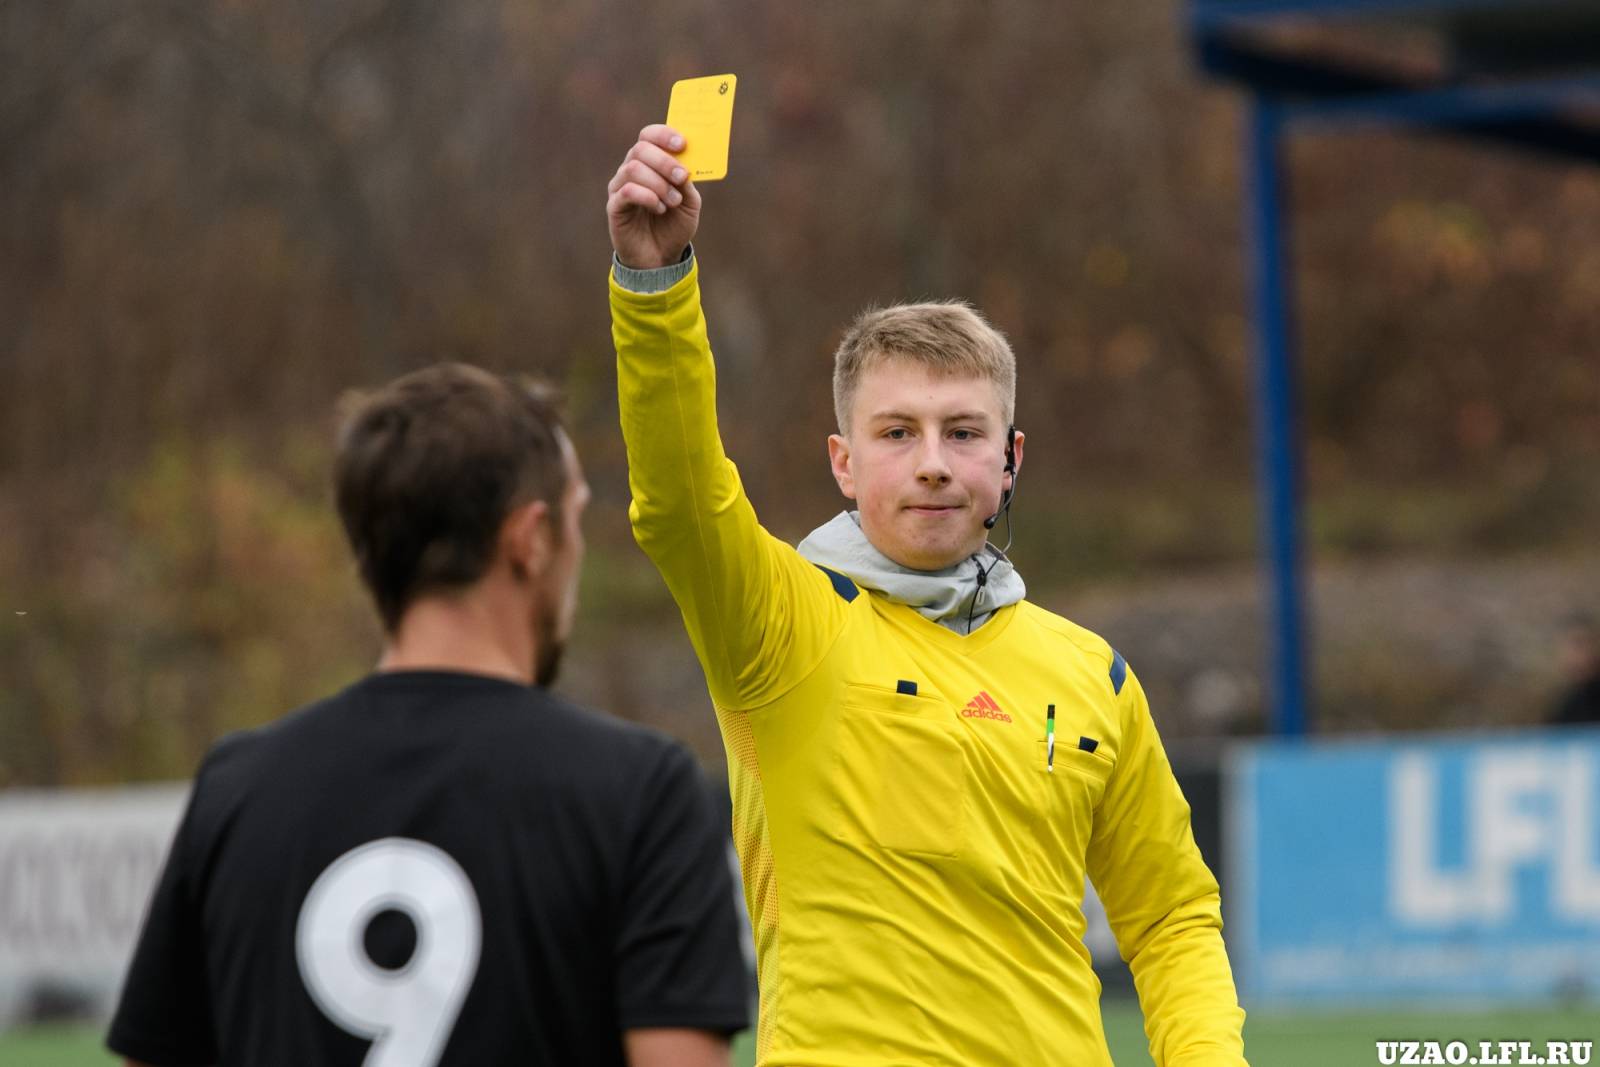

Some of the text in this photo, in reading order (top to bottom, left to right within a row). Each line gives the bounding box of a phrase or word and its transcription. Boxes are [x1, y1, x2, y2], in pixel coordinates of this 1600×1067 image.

[961, 707, 1012, 723] adidas
[1389, 748, 1600, 924] LFL
[295, 836, 482, 1067] 9
